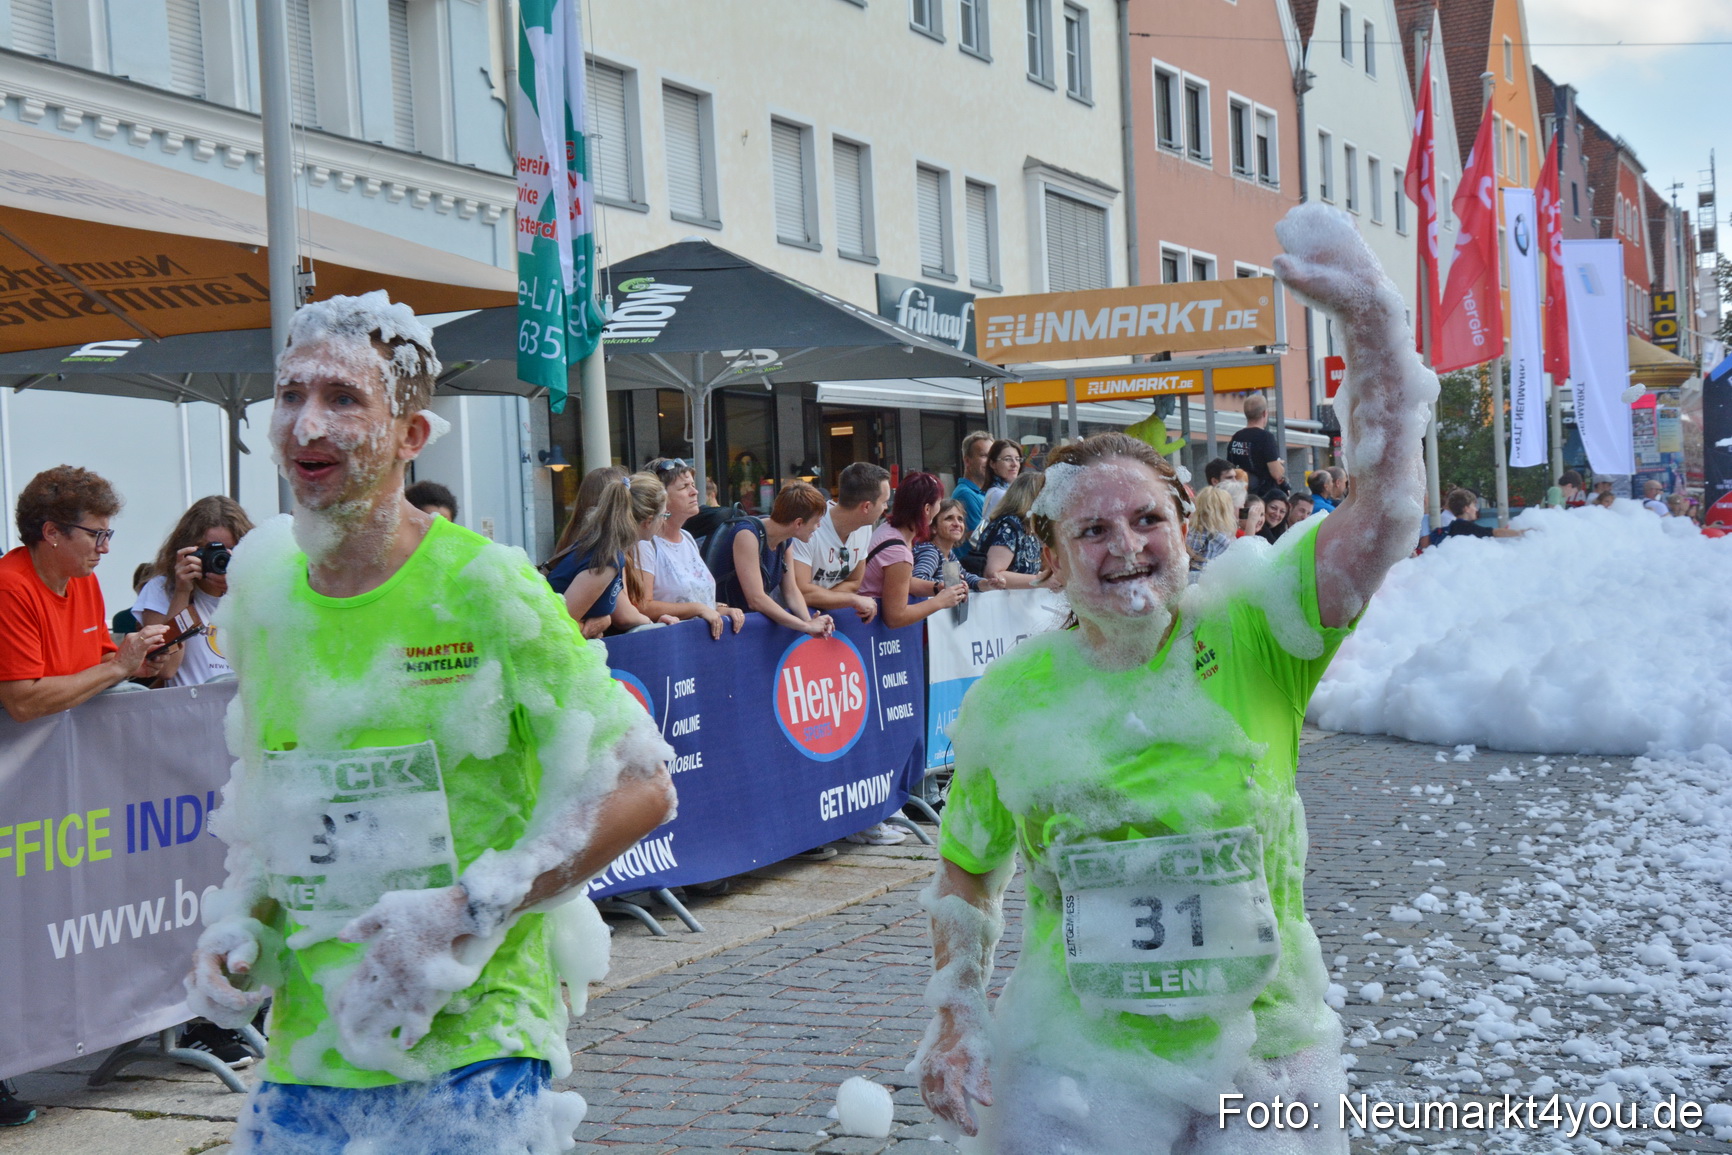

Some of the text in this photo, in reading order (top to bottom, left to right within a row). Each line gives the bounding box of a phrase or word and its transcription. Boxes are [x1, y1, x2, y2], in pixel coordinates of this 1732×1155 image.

[896, 287, 975, 352] frühauf
[986, 298, 1259, 348] RUNMARKT.DE
[1088, 376, 1194, 395] RUNMARKT.DE
[879, 640, 902, 657] STORE
[674, 678, 696, 699] STORE
[882, 671, 908, 689] ONLINE
[782, 662, 863, 727] Hervis
[886, 703, 914, 722] MOBILE
[672, 714, 700, 738] ONLINE
[668, 752, 703, 775] MOBILE
[820, 784, 845, 821] GET
[1131, 894, 1204, 950] 31
